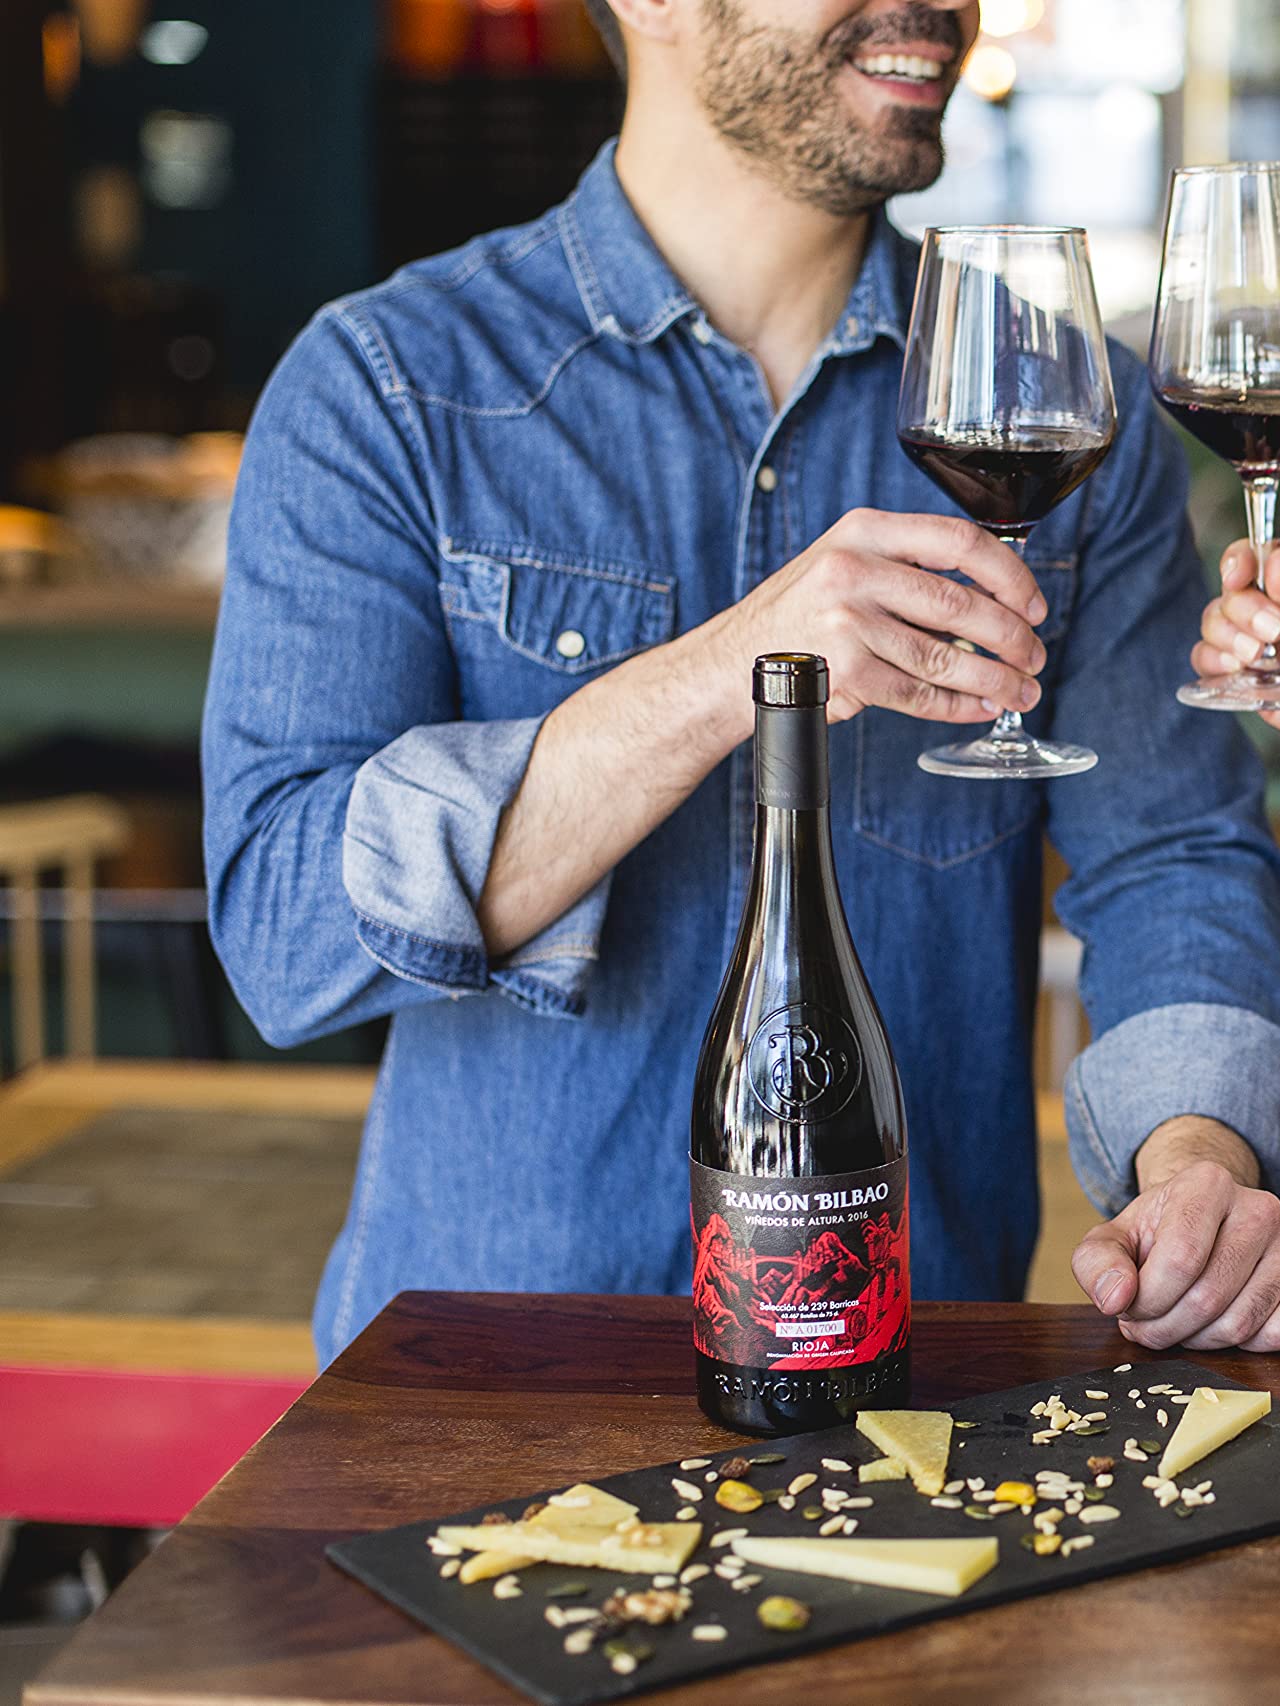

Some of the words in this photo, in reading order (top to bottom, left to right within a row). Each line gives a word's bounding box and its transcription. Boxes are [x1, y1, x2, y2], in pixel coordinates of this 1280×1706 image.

[722, 1189, 809, 1211] RAMÓN
[814, 1182, 889, 1210] BILBAO
[745, 1215, 788, 1227] VIÑEDOS
[792, 1217, 805, 1227] DE
[808, 1215, 845, 1227] ALTURA
[848, 1211, 869, 1222] 2016
[759, 1301, 796, 1311] Selección
[798, 1303, 809, 1311] de
[810, 1302, 828, 1311] 239
[830, 1299, 859, 1309] Barricas
[792, 1340, 829, 1351] RIOJA
[714, 1373, 813, 1402] RAMÓN
